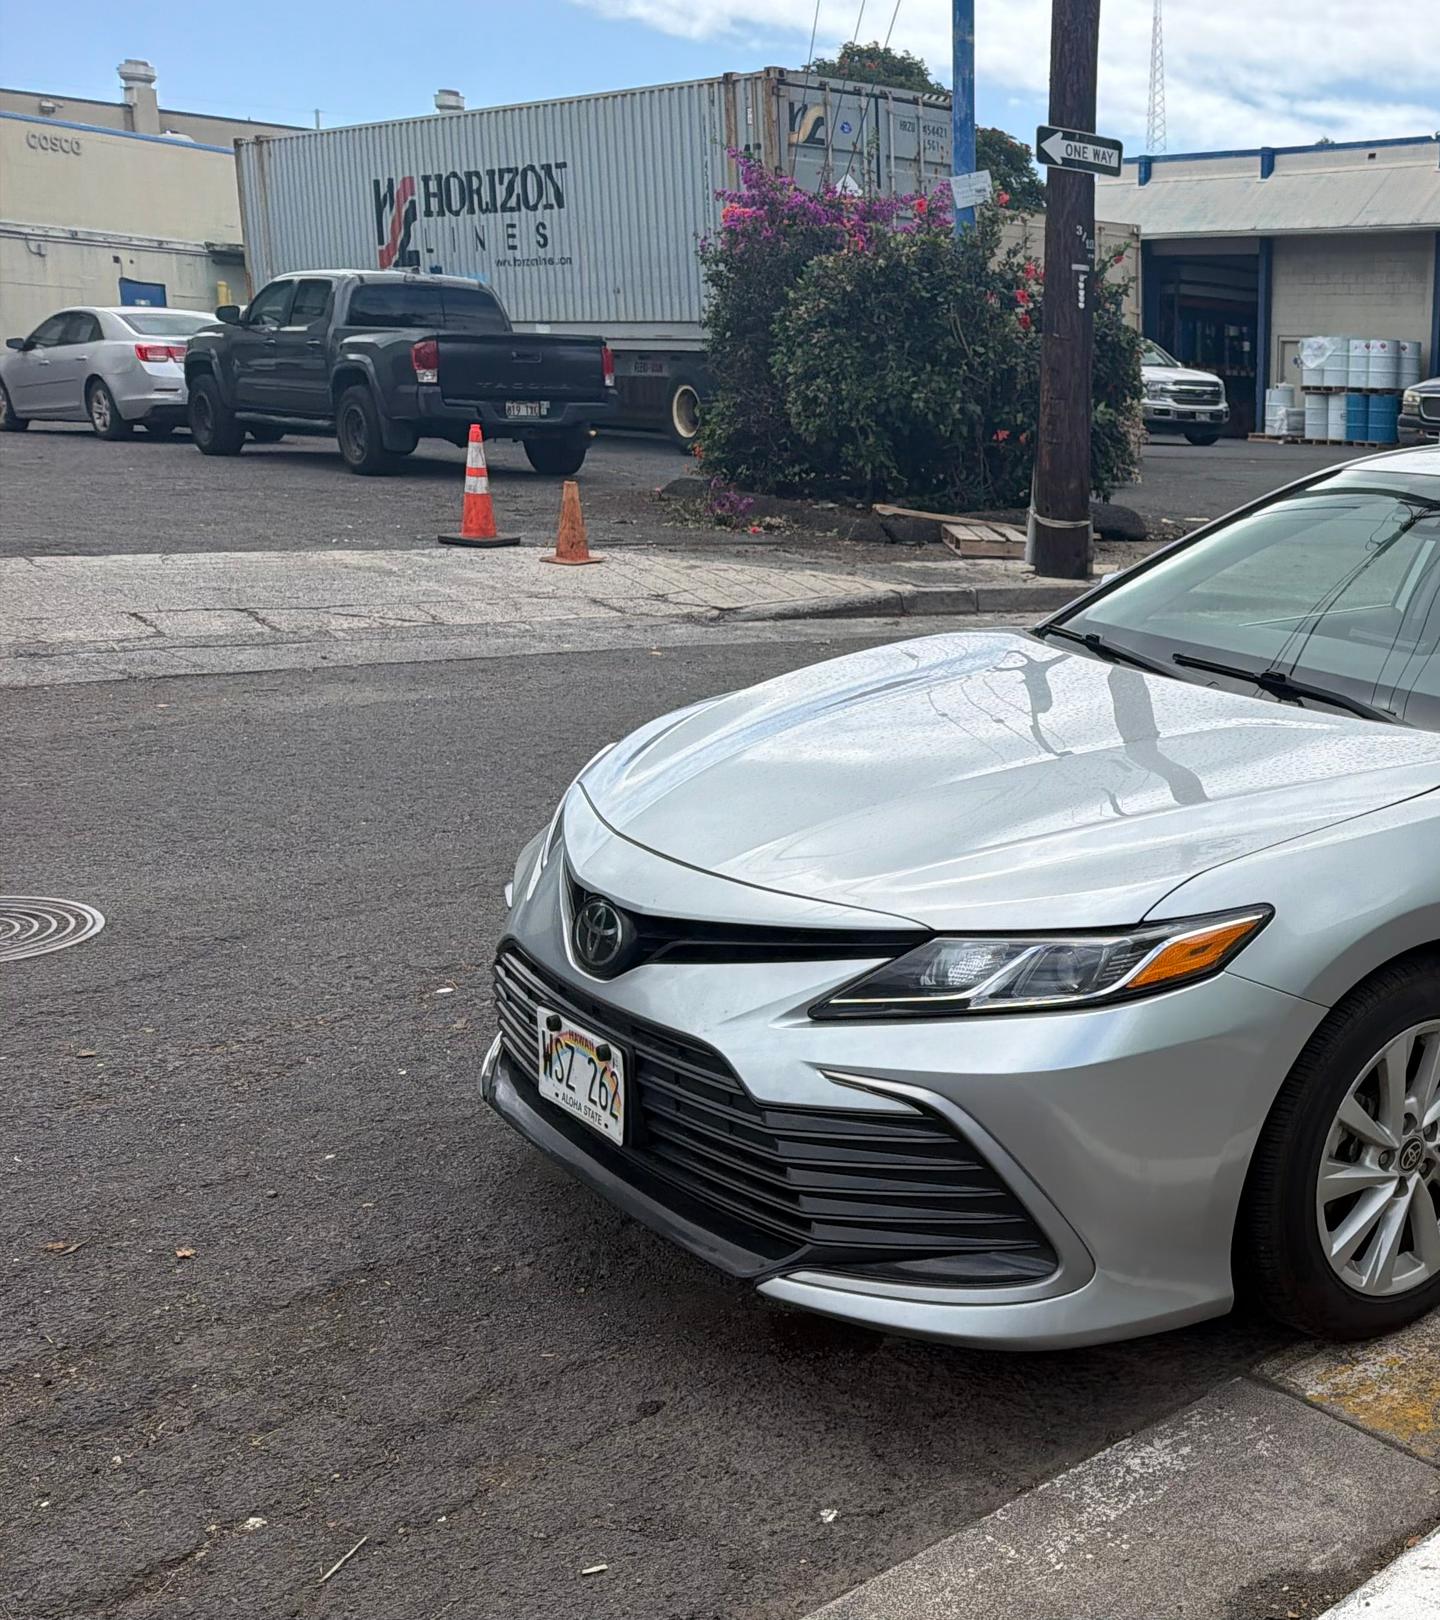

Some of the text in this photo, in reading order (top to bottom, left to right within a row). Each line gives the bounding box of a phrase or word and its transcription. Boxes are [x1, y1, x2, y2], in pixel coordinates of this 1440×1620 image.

[26, 132, 82, 156] COSCO
[1065, 143, 1115, 165] ONE WAY
[421, 161, 568, 219] HORIZON
[424, 221, 549, 254] LINES
[541, 1030, 619, 1121] WSZ 262
[561, 1093, 602, 1125] ALOHA STATE
